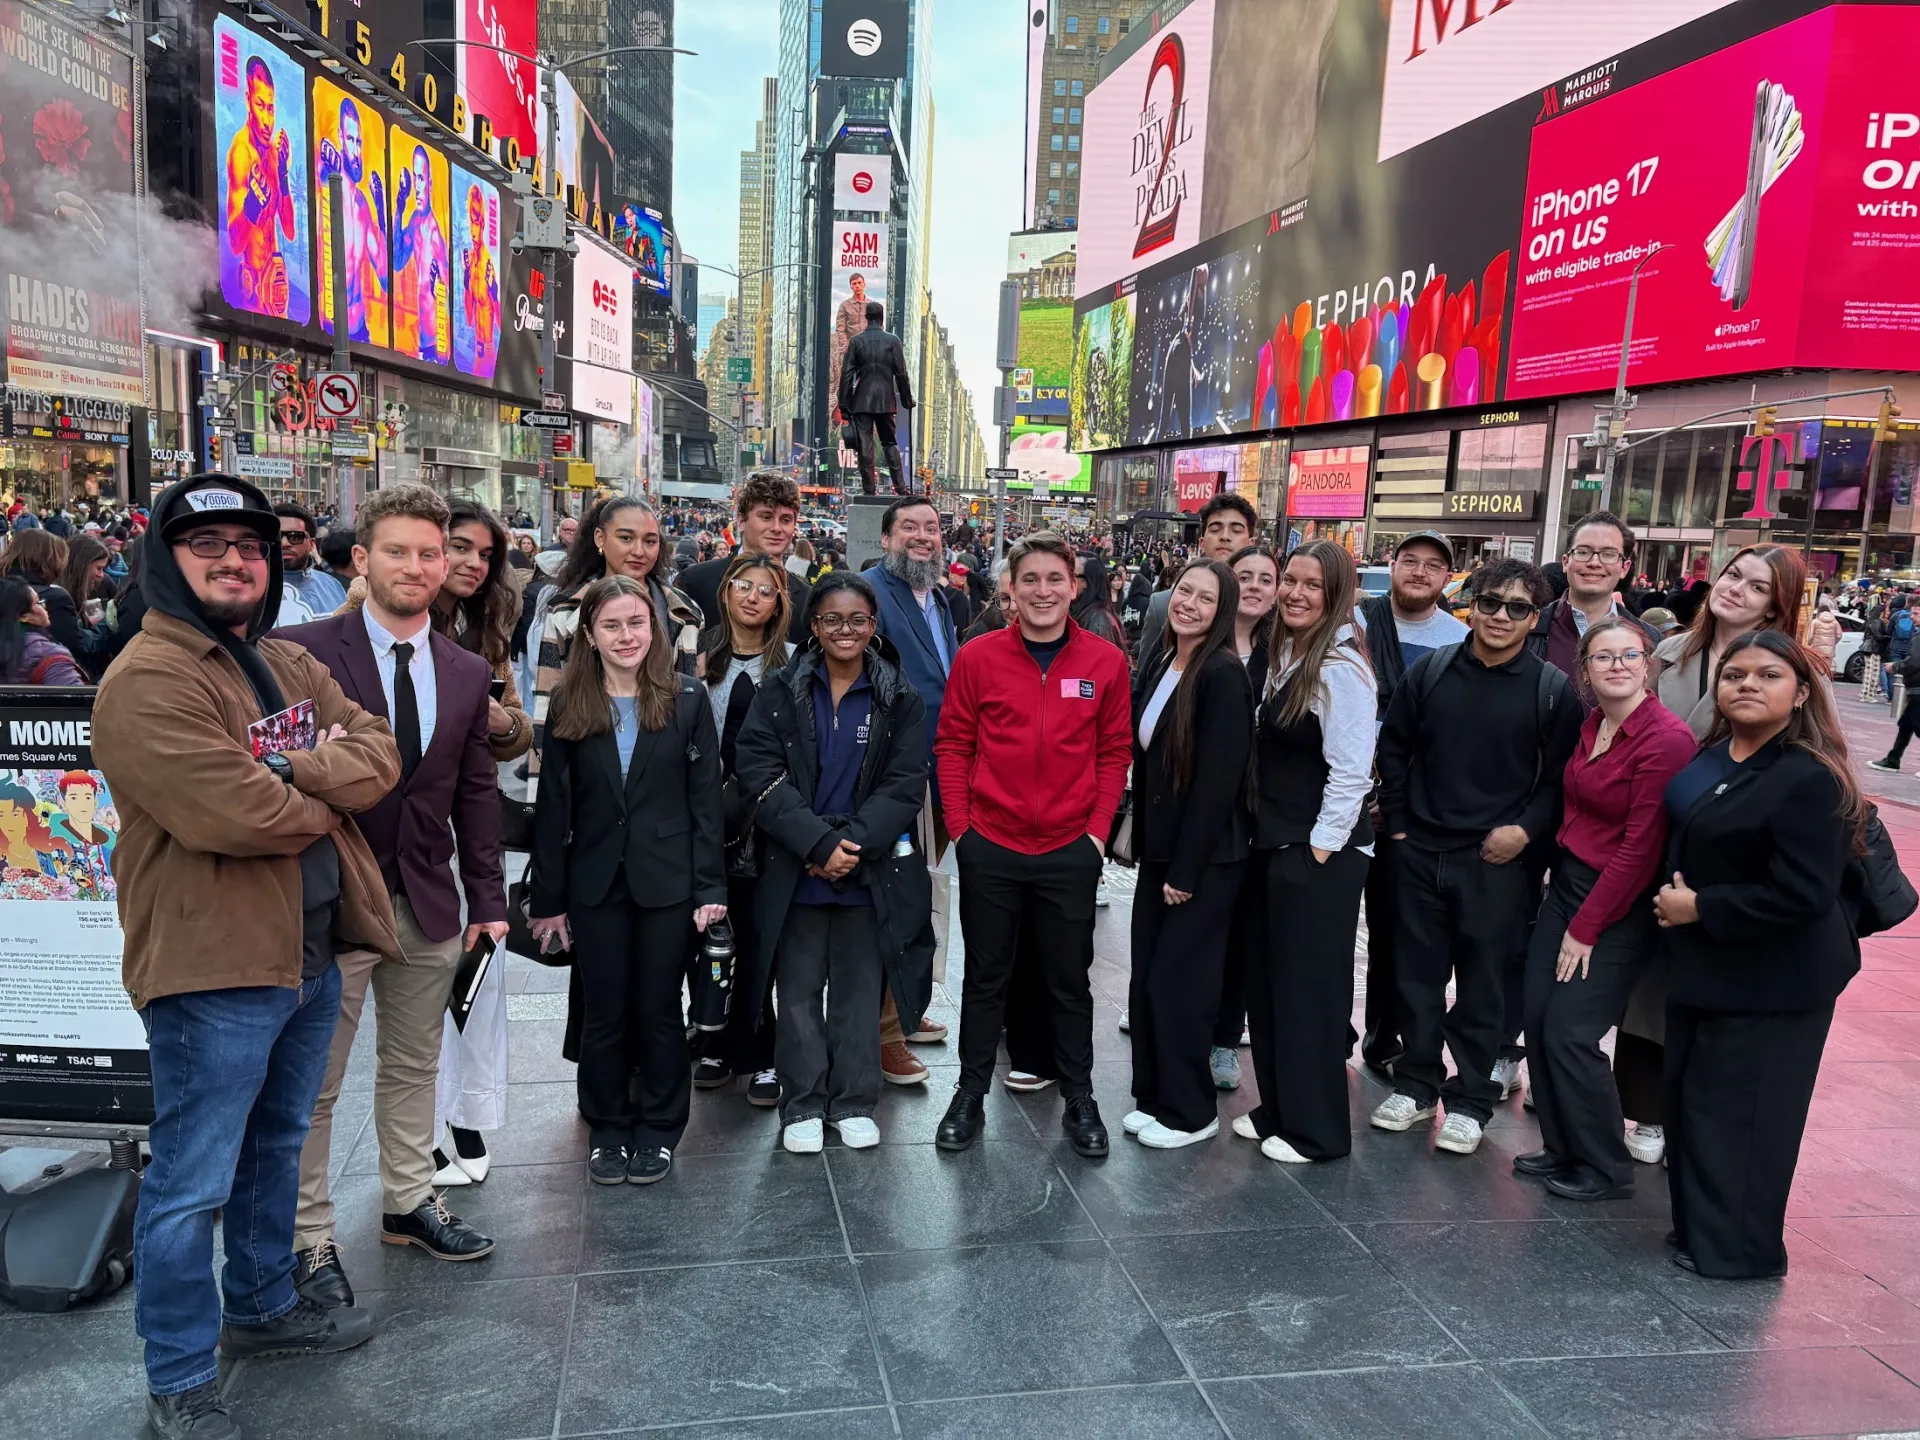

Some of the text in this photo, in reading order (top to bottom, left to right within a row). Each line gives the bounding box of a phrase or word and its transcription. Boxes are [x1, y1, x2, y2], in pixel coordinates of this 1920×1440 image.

[20, 10, 112, 75] COME SEE HOW THE
[0, 24, 129, 113] WORLD COULD BE
[221, 33, 239, 89] VAN
[1565, 59, 1619, 92] MARRIOTT
[1563, 78, 1612, 107] MARQUIS
[1139, 101, 1157, 129] THE
[1130, 98, 1193, 177] DEVIL
[452, 92, 617, 243] BROADWAY
[1147, 152, 1177, 186] WERS
[1134, 168, 1188, 227] PRADA
[1531, 155, 1660, 228] iPhone 17
[1280, 211, 1304, 228] MARQUIS
[1281, 199, 1308, 217] MARRIOTT
[1857, 200, 1918, 217] with
[488, 197, 499, 248] TAIRA
[842, 231, 878, 254] SAM
[1528, 213, 1609, 261] on us
[841, 254, 879, 268] BARBER
[1525, 238, 1662, 286] with eligible trade-in
[529, 268, 545, 300] UF
[1307, 263, 1437, 332] EPHORA
[9, 273, 141, 346] HADESTOWN
[1721, 319, 1761, 336] iPhone 17
[11, 324, 67, 345] BROADWAY'S
[68, 334, 99, 351] GLOBAL
[100, 341, 142, 360] SENSATION
[1705, 343, 1716, 351] Built
[1723, 340, 1737, 350] Apple
[5, 389, 131, 423] GIFTS LUGGAGE
[527, 414, 565, 426] ONE WAY
[1480, 411, 1520, 425] SEPHORA
[33, 426, 53, 437] Nikon
[57, 430, 81, 440] Canon
[85, 431, 109, 442] SONY
[151, 448, 196, 462] POLO ASSN.
[1300, 470, 1352, 490] PANDORA
[1587, 481, 1596, 489] 46
[1450, 494, 1523, 513] SEPHORA
[9, 720, 91, 746] MOME
[22, 751, 56, 763] Square
[57, 752, 78, 762] Arts
[16, 1053, 39, 1063] NYC
[66, 1056, 93, 1065] TSAC
